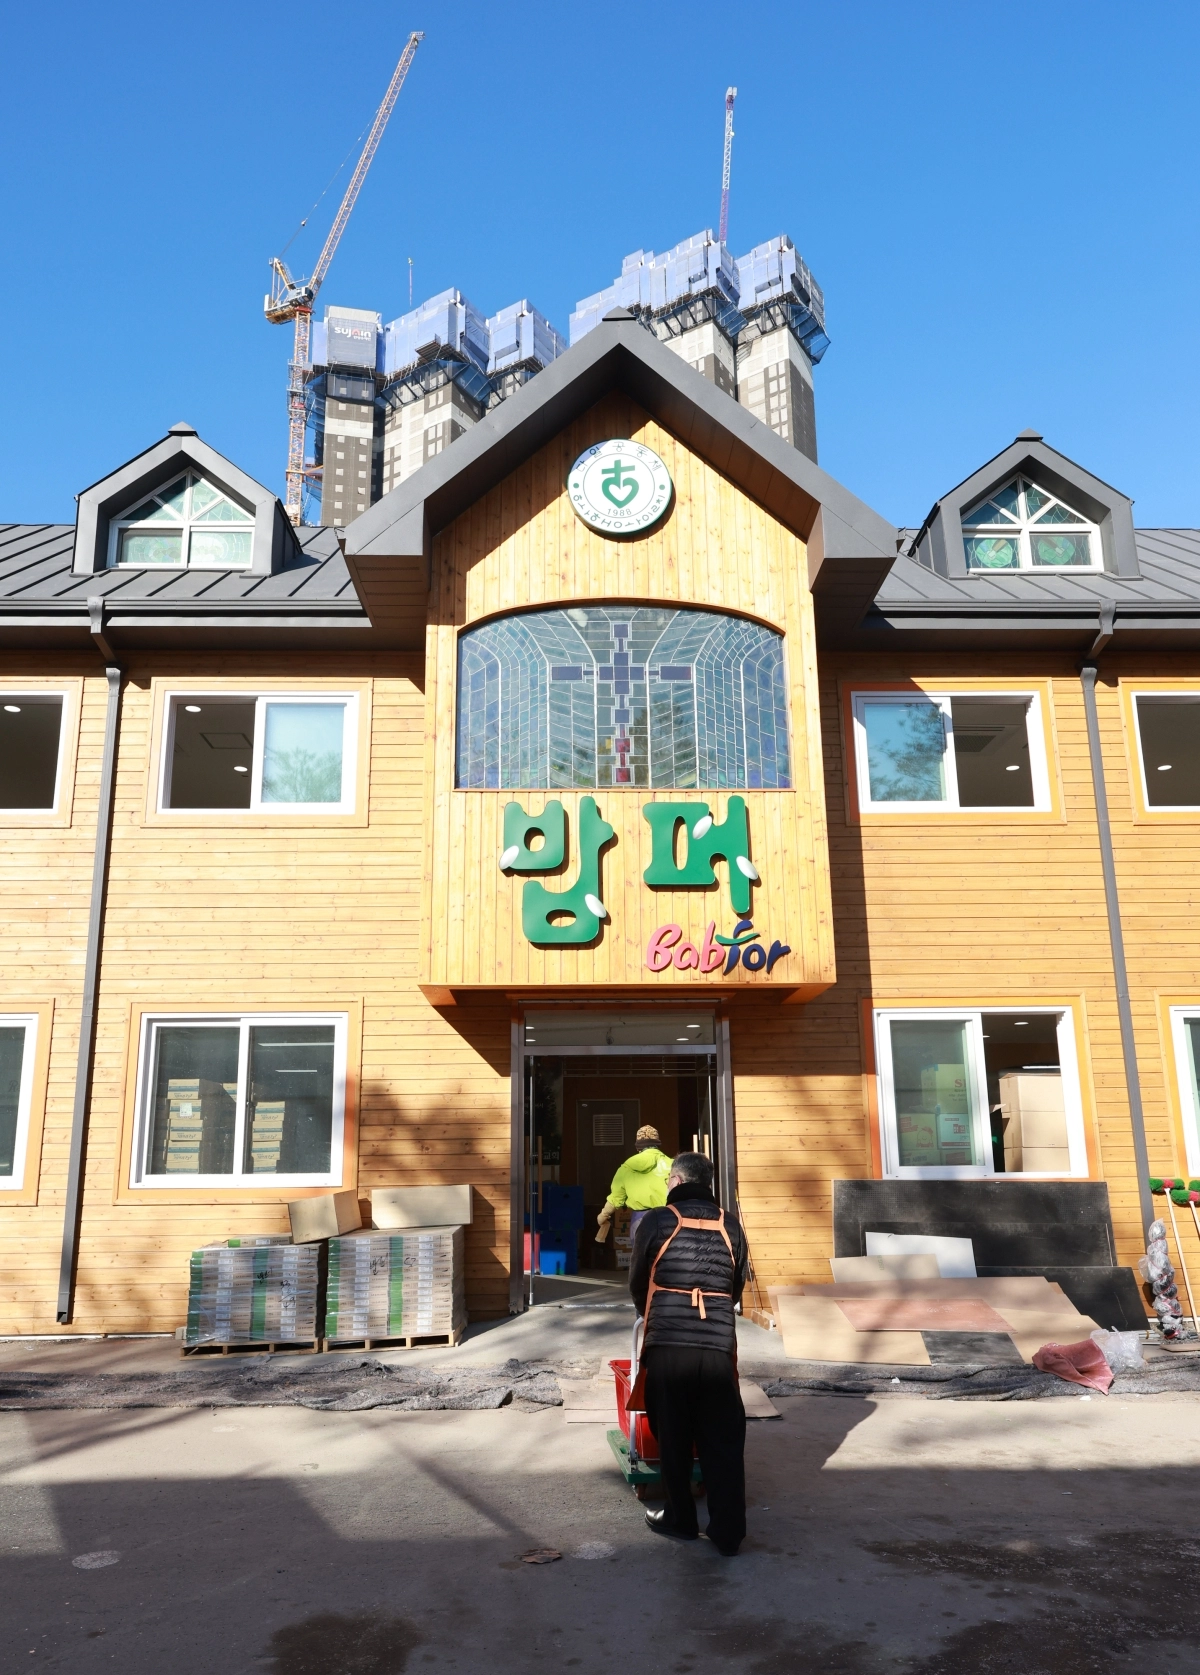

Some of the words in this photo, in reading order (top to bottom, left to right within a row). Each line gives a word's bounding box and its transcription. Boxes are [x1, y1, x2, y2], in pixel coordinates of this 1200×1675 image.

[335, 327, 371, 338] sujain
[607, 508, 632, 517] 1988
[646, 919, 791, 975] Babfor
